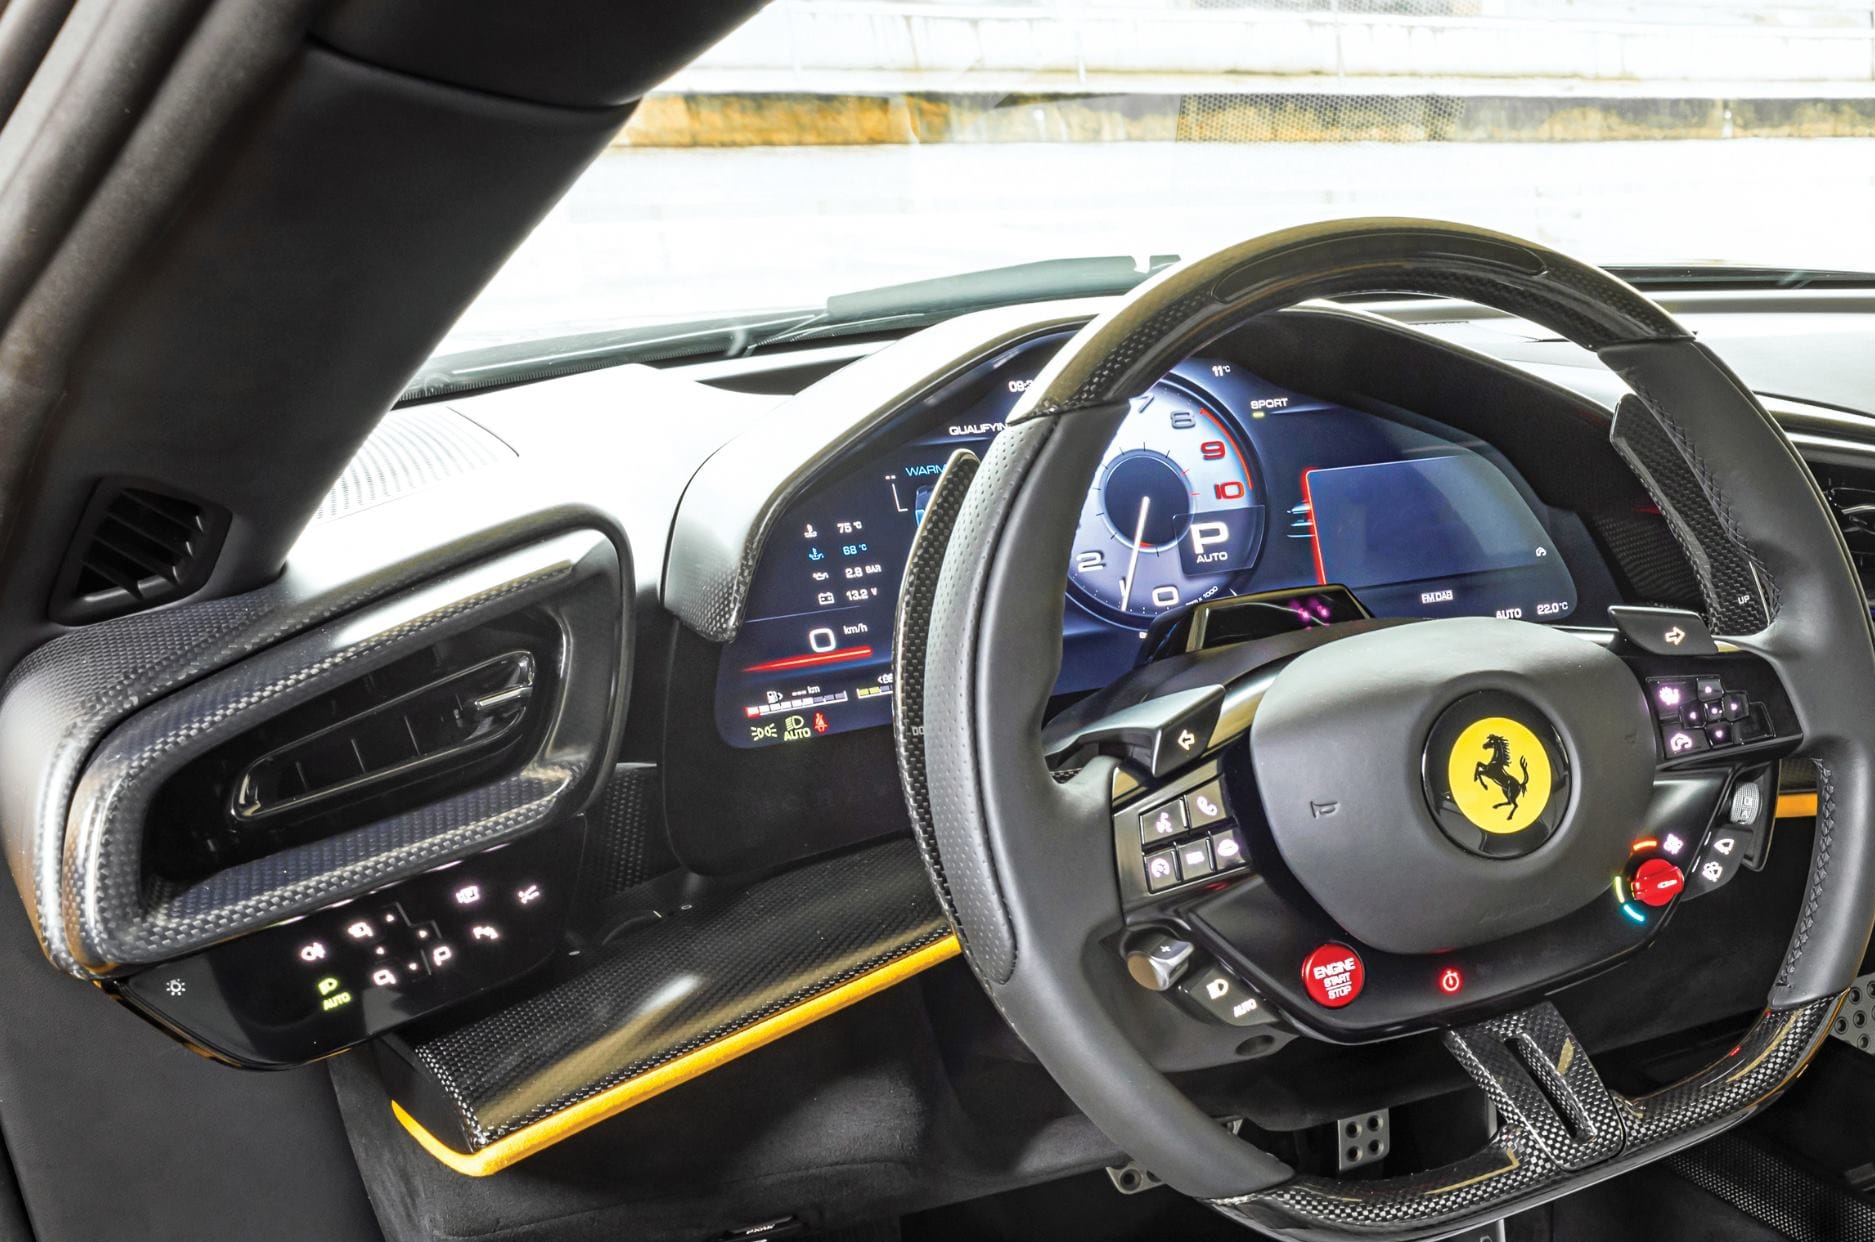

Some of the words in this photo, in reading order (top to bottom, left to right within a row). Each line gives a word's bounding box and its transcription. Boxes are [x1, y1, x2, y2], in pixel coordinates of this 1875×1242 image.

[1212, 364, 1231, 377] 11°C
[1250, 397, 1288, 410] SPORT
[1170, 409, 1196, 429] 8
[1201, 440, 1226, 460] 9
[1214, 481, 1246, 500] 10
[836, 522, 853, 534] 75
[1190, 520, 1230, 554] P
[842, 545, 858, 556] 68
[1196, 551, 1229, 565] AUTO
[1075, 550, 1106, 573] 2
[844, 566, 864, 579] 2.8
[864, 563, 883, 574] BAR
[845, 588, 869, 601] 13.2
[870, 586, 878, 596] V
[1151, 586, 1179, 607] 0
[1421, 591, 1435, 604] FM
[1435, 589, 1454, 602] DAB
[1737, 594, 1751, 605] UP
[1495, 607, 1522, 620] AUTO
[1536, 603, 1559, 615] 22.0
[808, 627, 837, 653] 0
[842, 622, 869, 635] km/h
[806, 684, 821, 695] km
[783, 726, 812, 742] AUTO
[1312, 956, 1356, 981] ENGINE
[1322, 971, 1351, 989] START
[1326, 985, 1353, 1001] STOP
[322, 991, 352, 1012] AUTO
[1232, 998, 1258, 1019] AUTO
